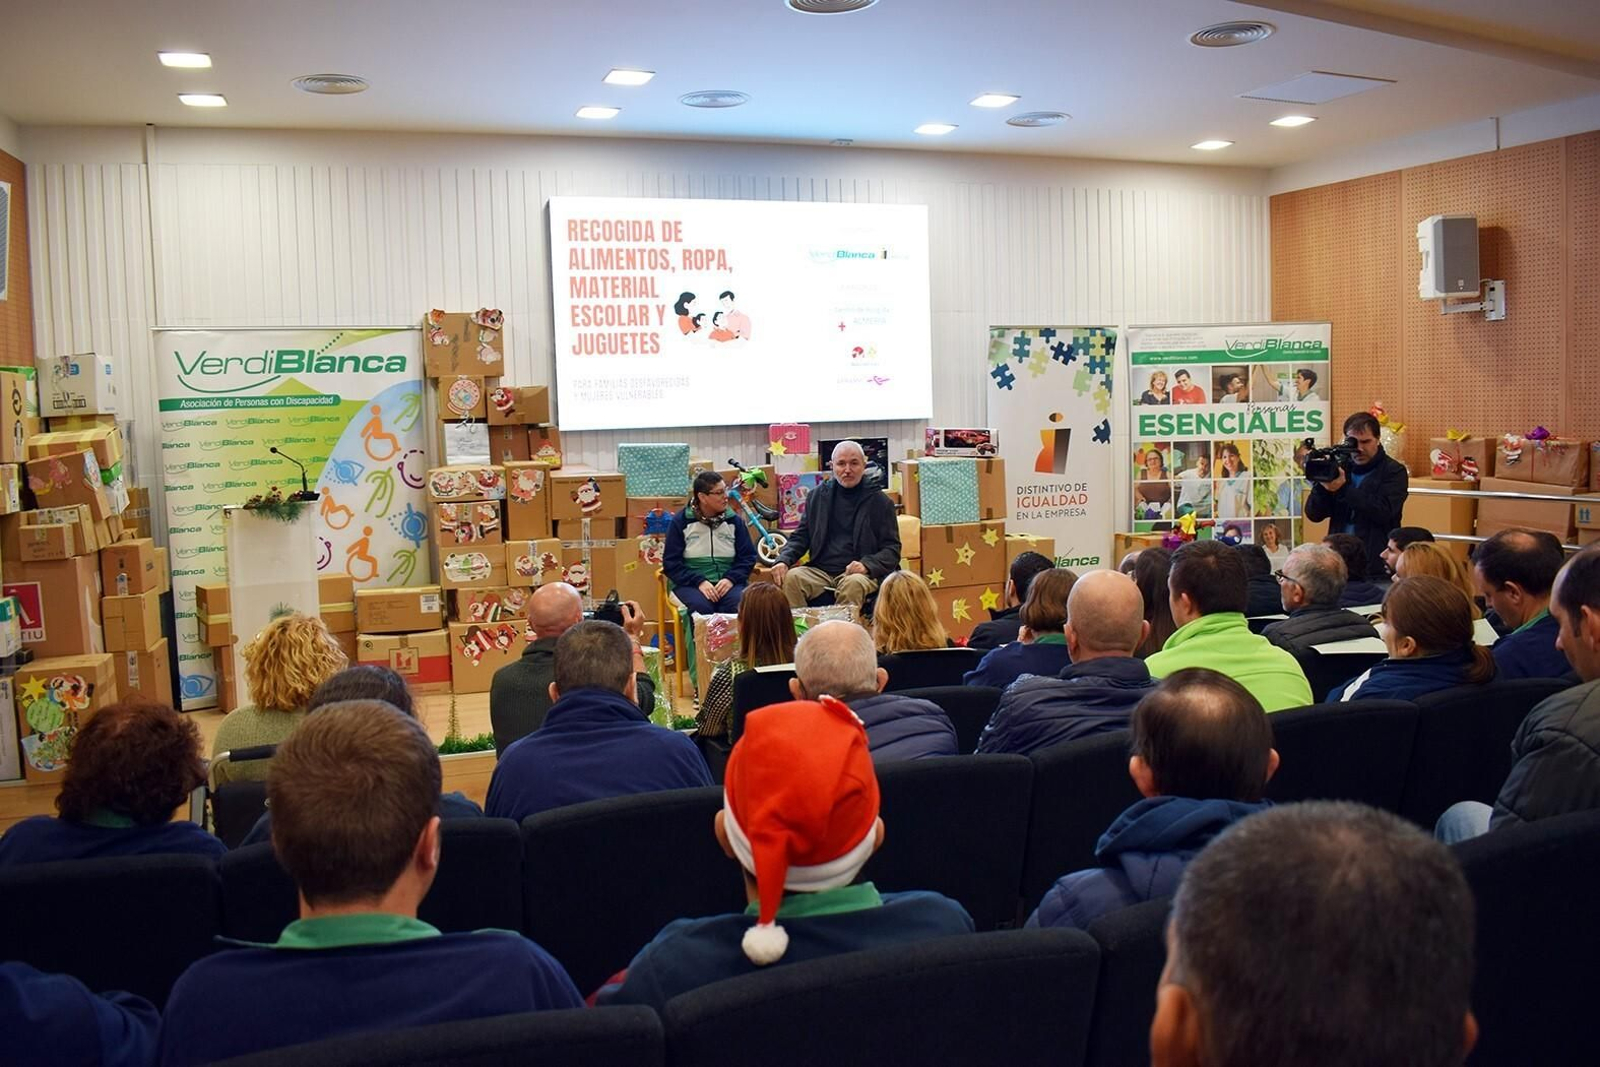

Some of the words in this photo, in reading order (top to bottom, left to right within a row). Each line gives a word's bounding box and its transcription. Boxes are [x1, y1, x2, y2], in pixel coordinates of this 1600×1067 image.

[567, 219, 656, 243] RECOGIDA
[661, 220, 683, 243] DE
[568, 248, 676, 273] ALIMENTOS,
[682, 248, 734, 274] ROPA,
[569, 276, 660, 299] MATERIAL
[570, 304, 650, 327] ESCOLAR
[654, 304, 666, 326] Y
[571, 332, 661, 355] JUGUETES
[1225, 338, 1323, 351] VerdiBlanca
[174, 350, 407, 375] VerdiBlanca
[180, 398, 222, 408] Asociación
[223, 398, 233, 407] de
[235, 397, 269, 407] Personas
[270, 398, 284, 406] con
[285, 396, 334, 406] Discapacidad
[1138, 409, 1324, 437] ESENCIALES
[1017, 484, 1072, 495] DISTINTIVO
[1074, 482, 1088, 492] DE
[172, 504, 223, 513] VerdiBlanc
[1017, 494, 1088, 508] IGUALDAD
[1016, 511, 1029, 520] EN
[1032, 510, 1042, 519] LA
[1046, 508, 1087, 518] EMPRESA
